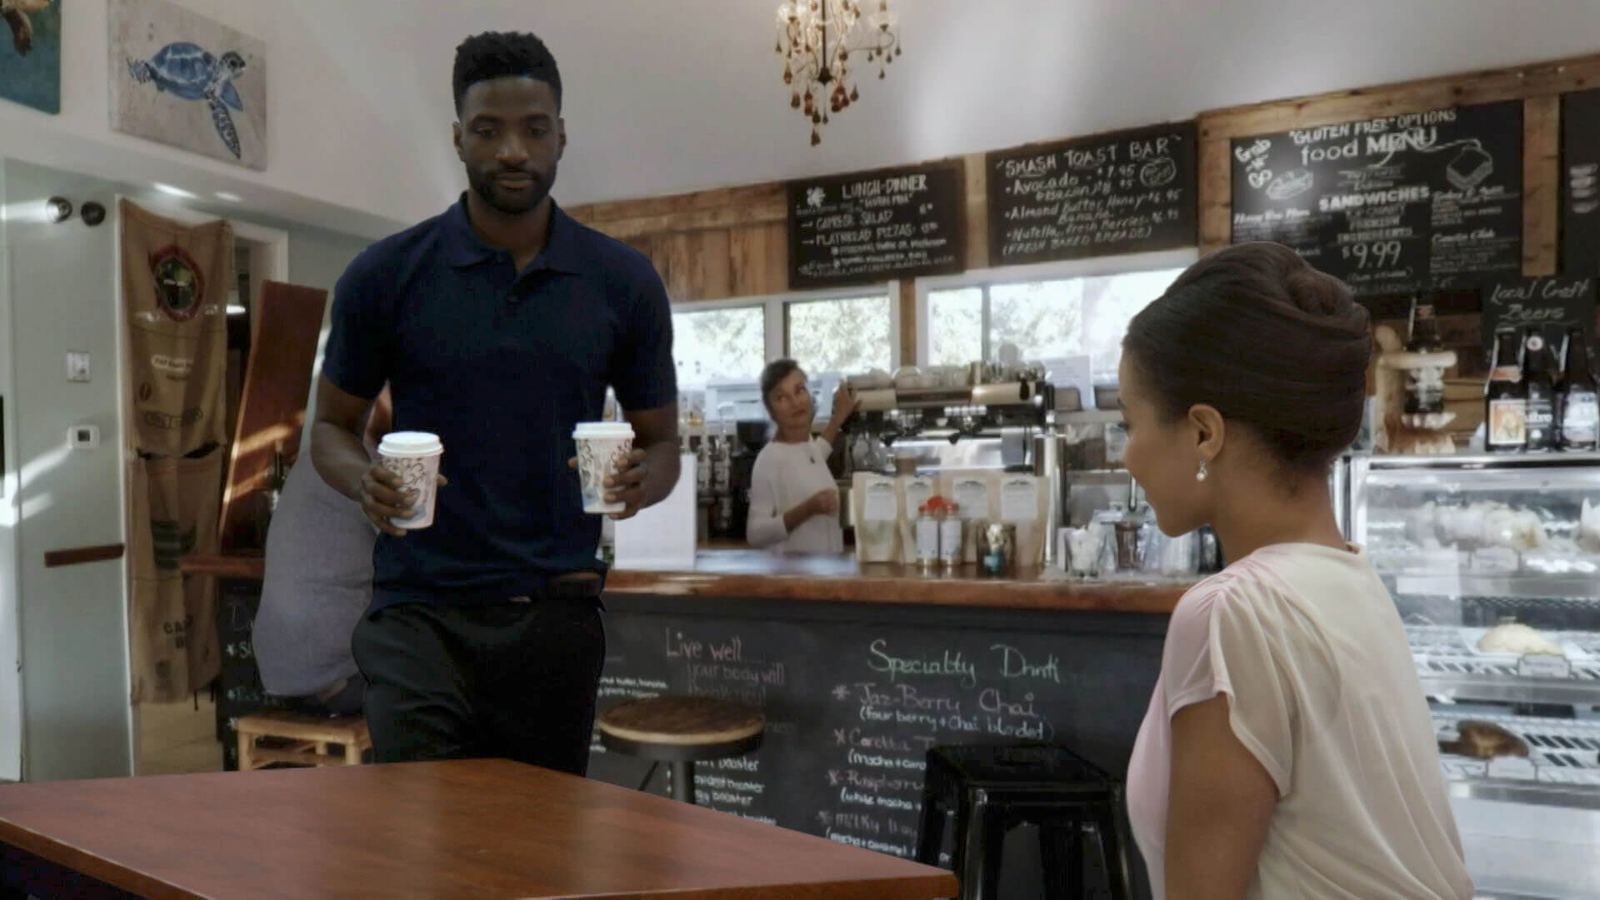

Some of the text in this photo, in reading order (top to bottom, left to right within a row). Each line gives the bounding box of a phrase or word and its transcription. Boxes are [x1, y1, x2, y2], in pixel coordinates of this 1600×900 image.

[1397, 110, 1456, 128] OPTIONS
[1064, 146, 1117, 167] TOAST
[1130, 138, 1169, 158] BAR
[1366, 127, 1437, 154] MENU
[1319, 186, 1430, 212] SANDWICHES
[1341, 241, 1402, 268] $9.99
[666, 628, 742, 662] Live well
[868, 640, 976, 688] Specialty
[979, 688, 1036, 717] Chai
